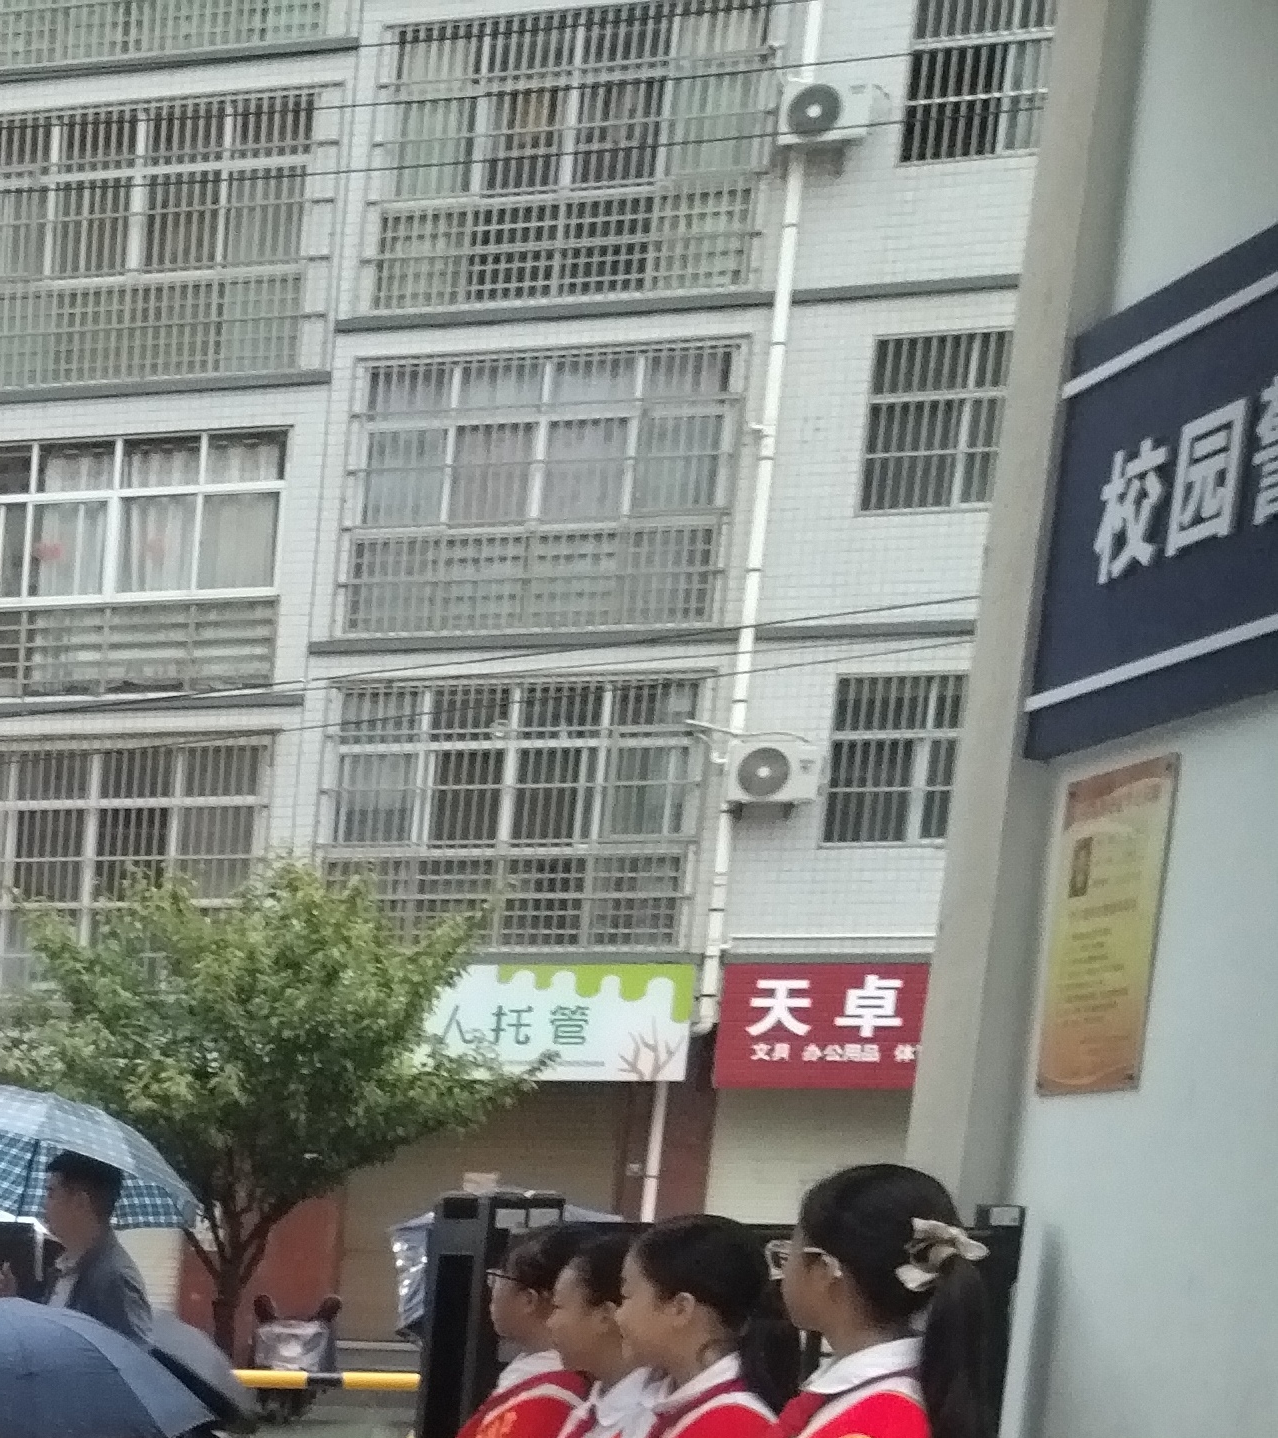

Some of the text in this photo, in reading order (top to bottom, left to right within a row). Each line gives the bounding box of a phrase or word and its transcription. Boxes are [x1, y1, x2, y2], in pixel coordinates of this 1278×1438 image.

[745, 974, 903, 1038] 天卓
[750, 1043, 791, 1061] 文具
[894, 1043, 922, 1063] 体
